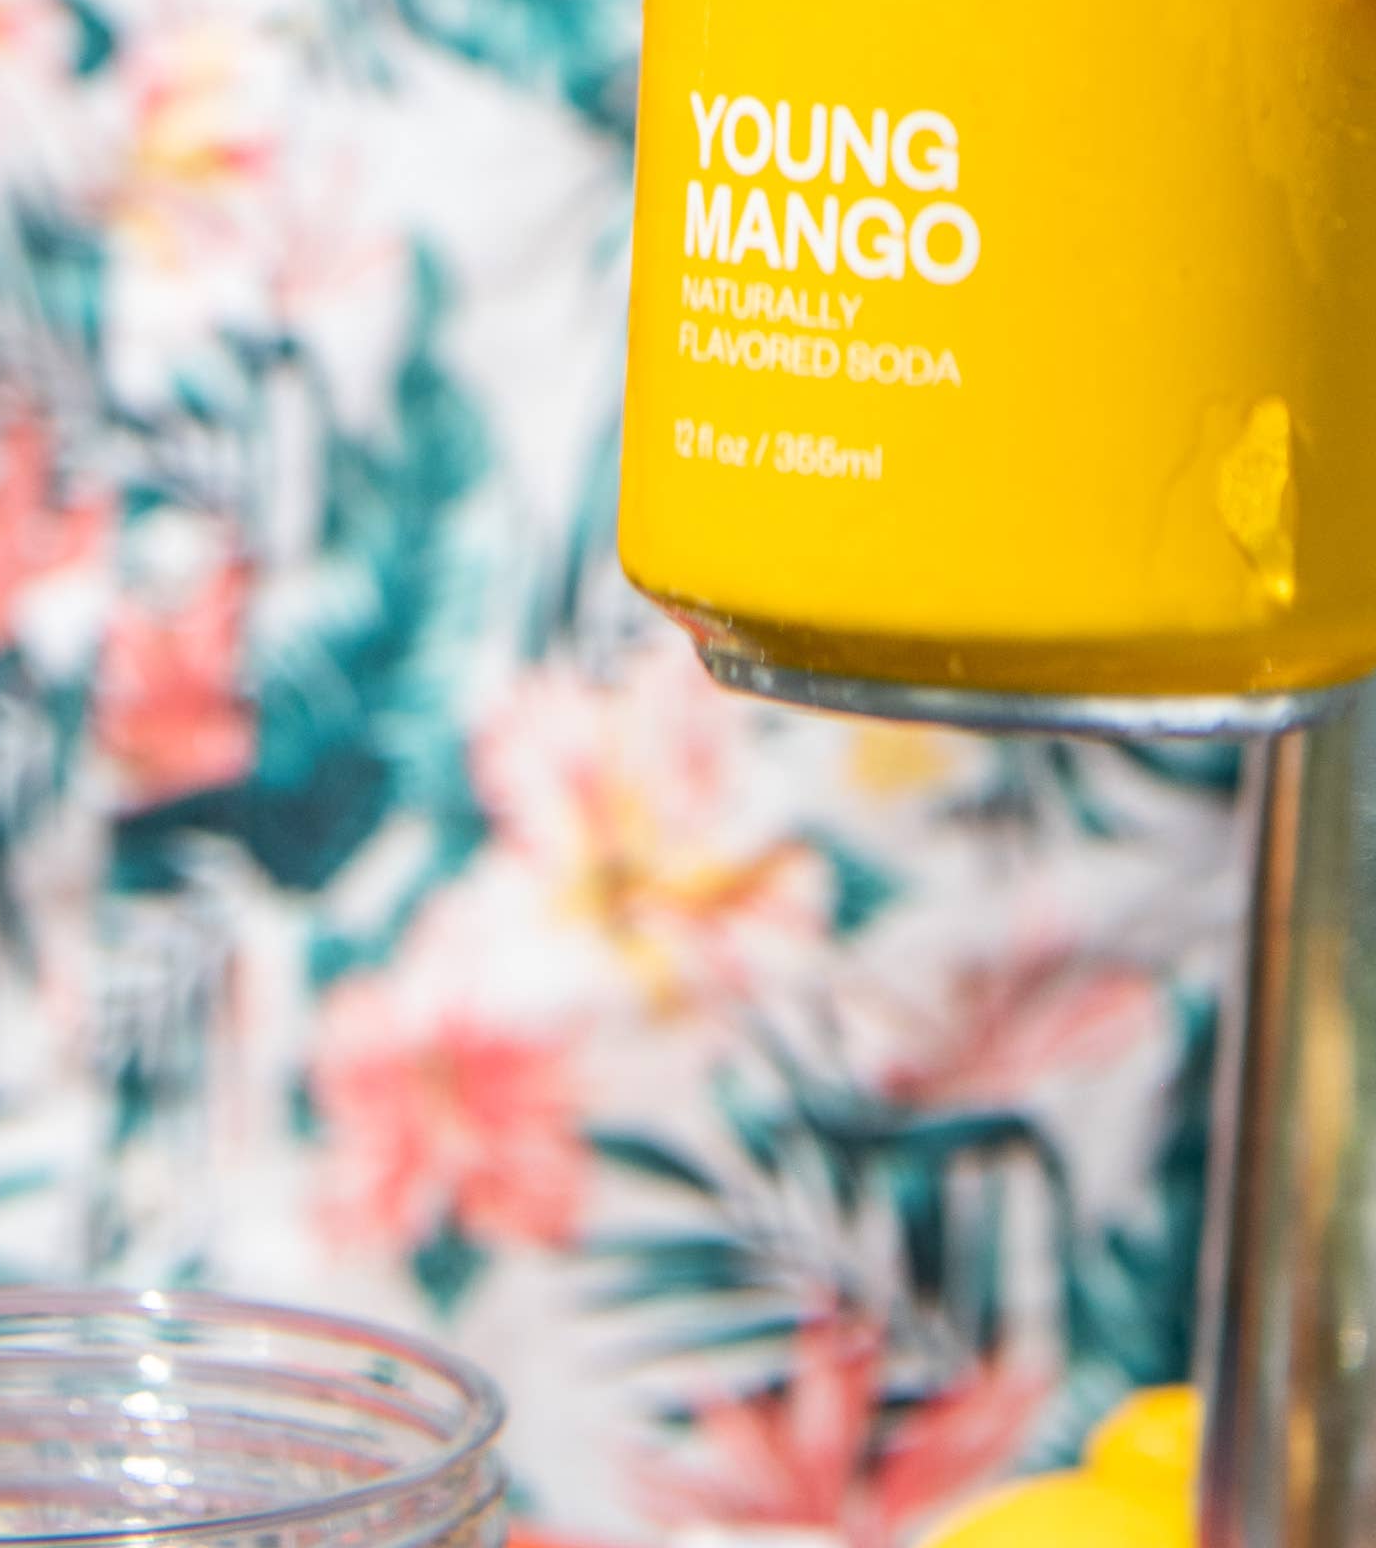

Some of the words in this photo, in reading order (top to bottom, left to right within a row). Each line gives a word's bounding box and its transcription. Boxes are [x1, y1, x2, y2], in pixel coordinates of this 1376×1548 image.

[690, 90, 959, 192] YOUNG
[684, 179, 981, 286] MANGO
[681, 274, 864, 331] NATURALLY
[678, 319, 841, 379] FLAVORED
[845, 340, 962, 388] SODA
[674, 417, 695, 459] 12
[716, 433, 750, 468] oz
[774, 431, 883, 481] 355ml
